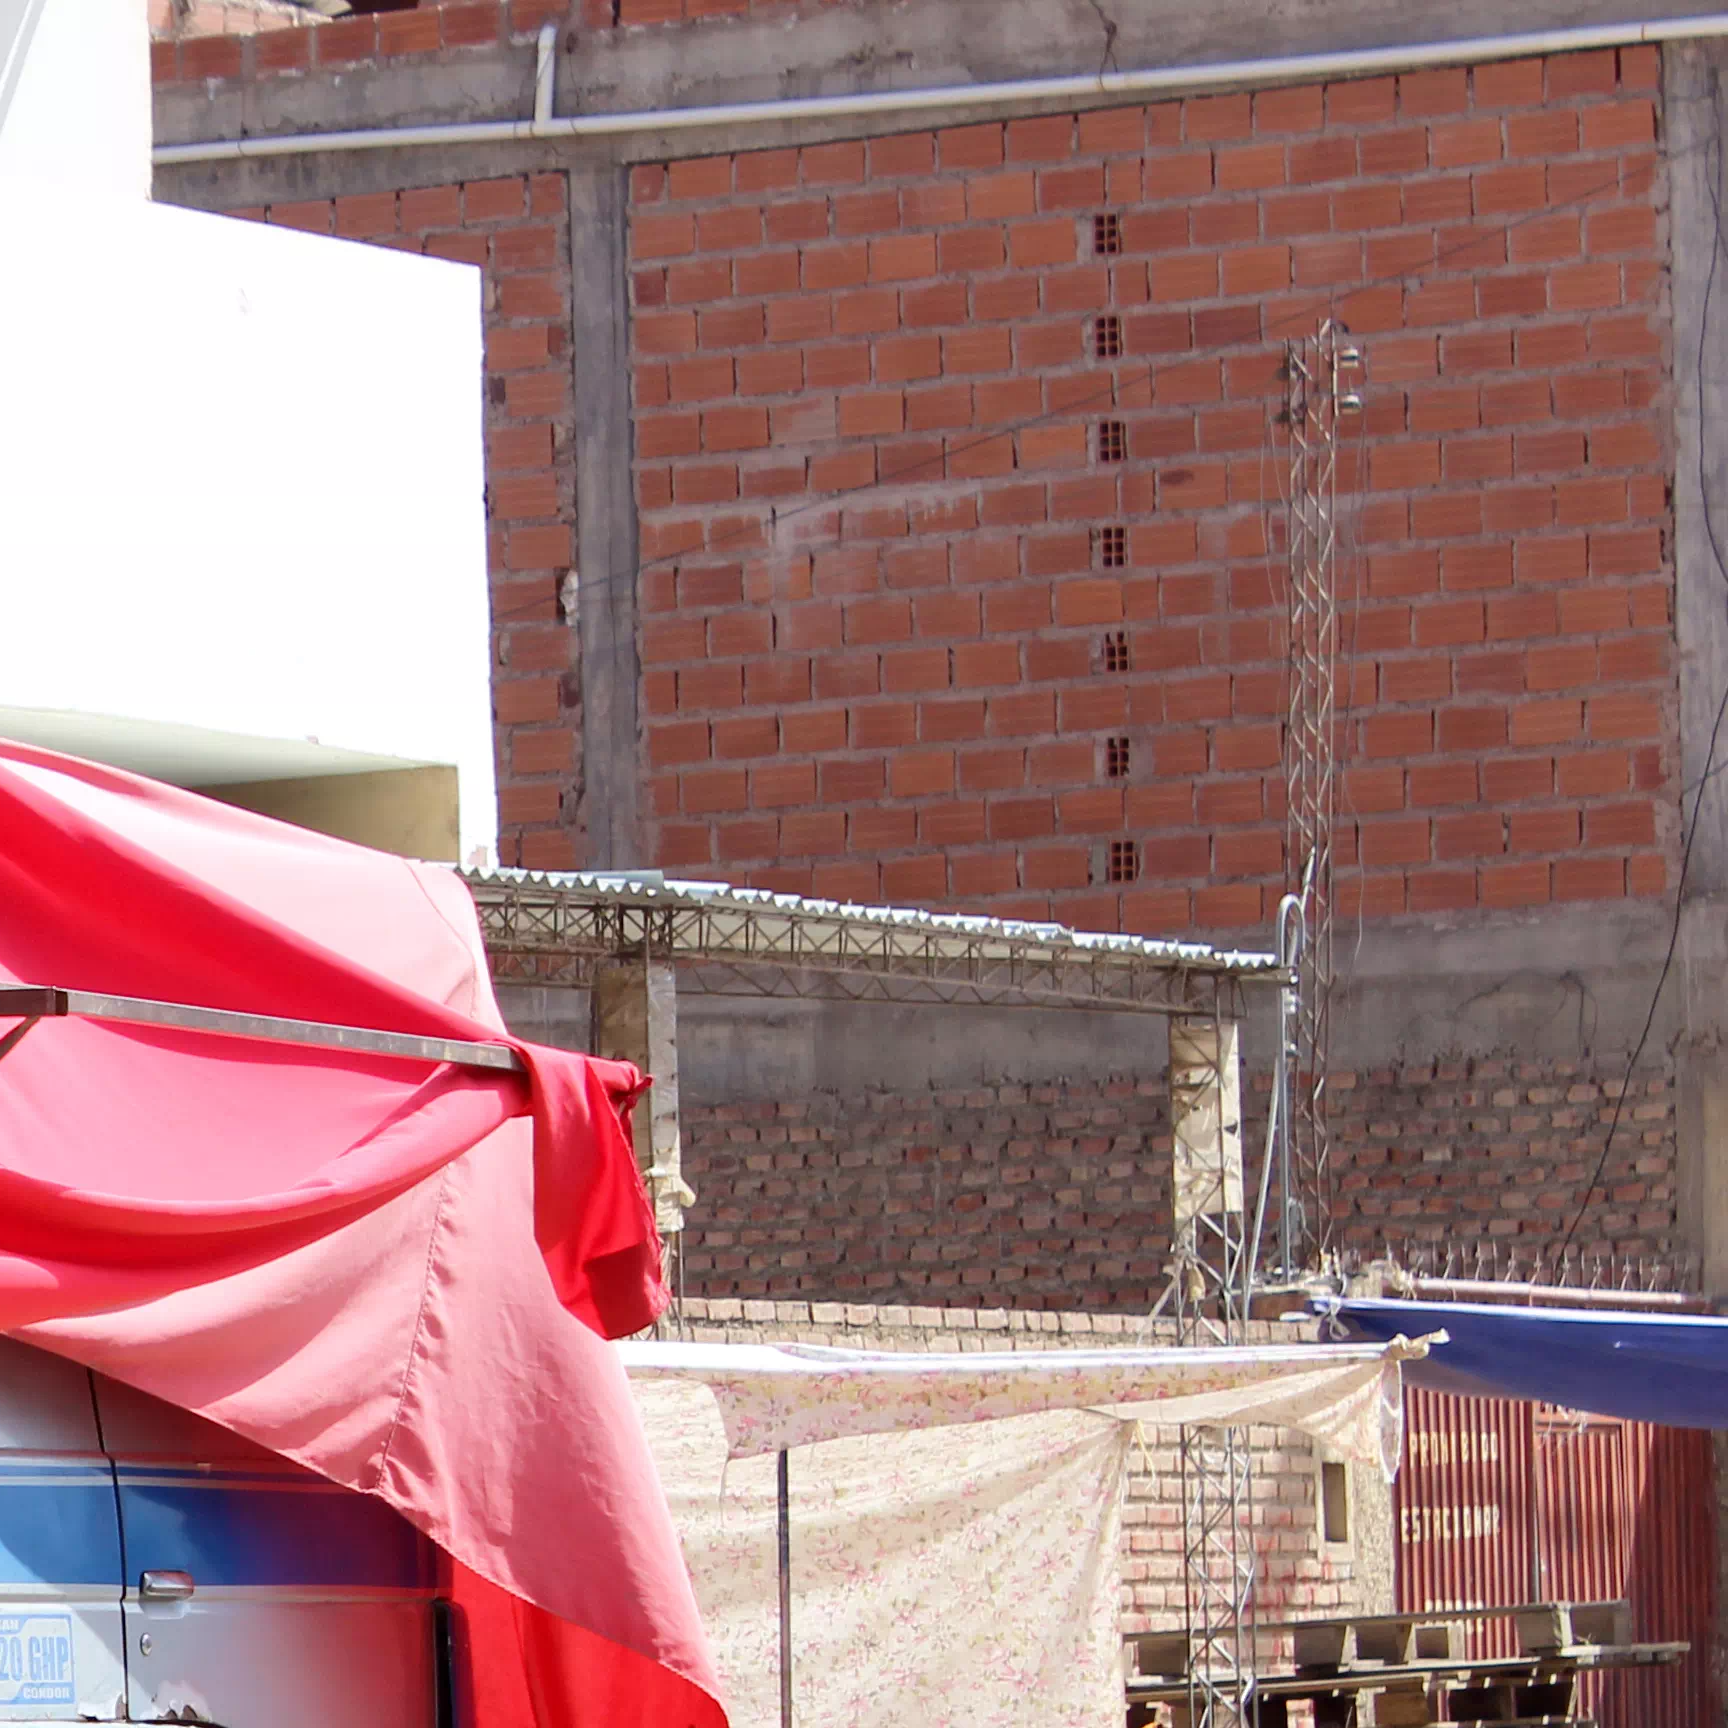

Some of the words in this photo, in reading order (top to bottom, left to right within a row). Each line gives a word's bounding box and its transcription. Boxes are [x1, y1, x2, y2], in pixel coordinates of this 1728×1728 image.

[1409, 1430, 1498, 1469] PROHIBIDO
[1400, 1503, 1501, 1544] ESTACIONAR
[28, 1636, 69, 1682] GHP
[23, 1686, 70, 1699] CONDOR
